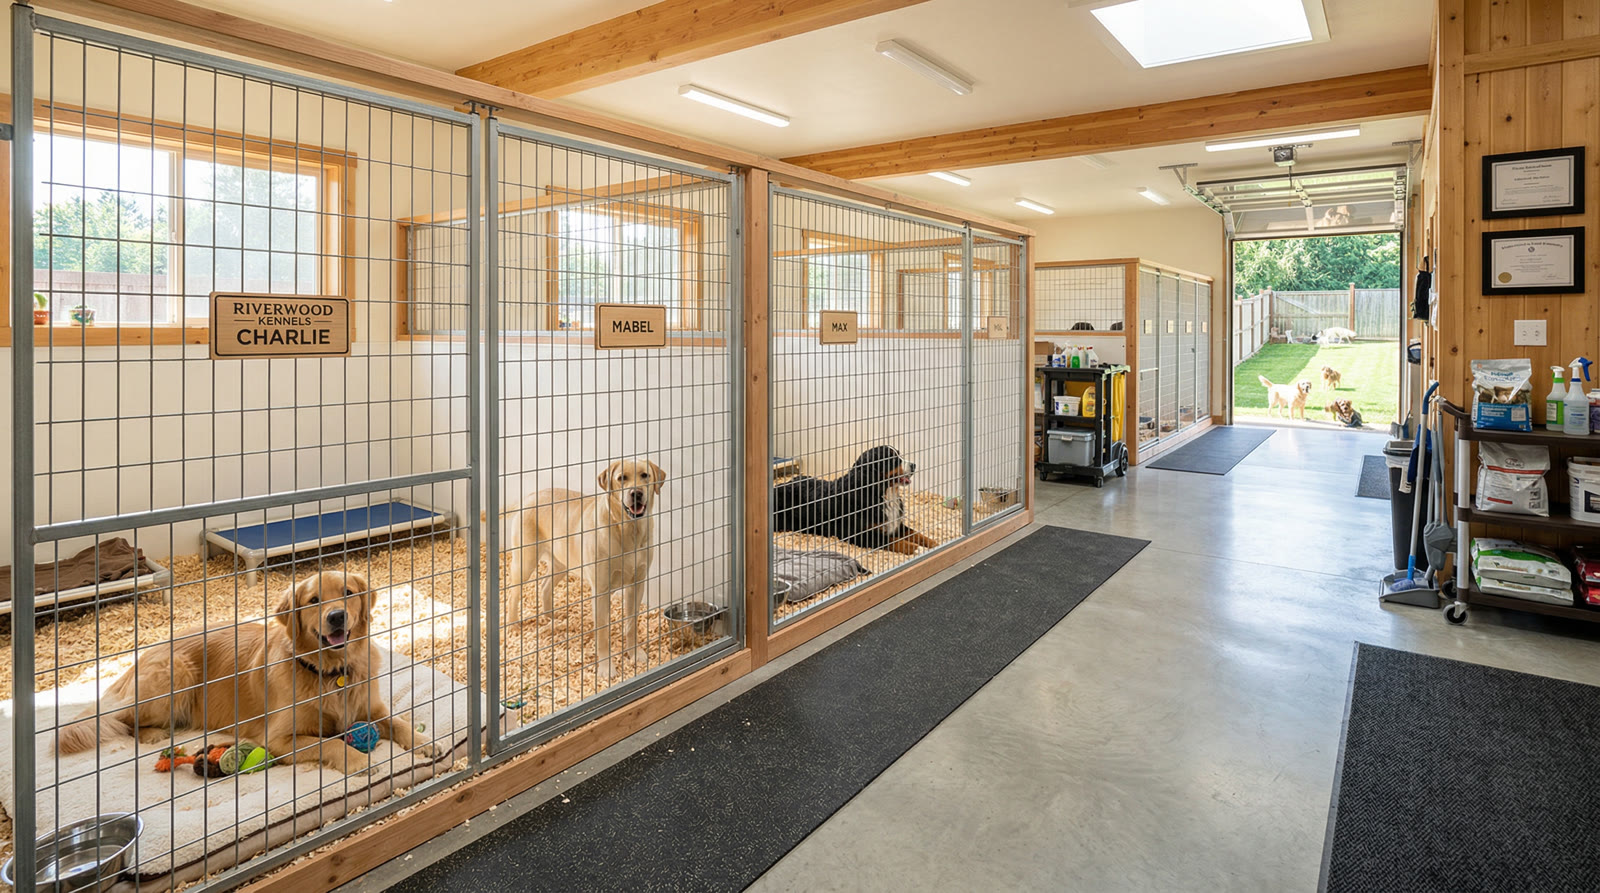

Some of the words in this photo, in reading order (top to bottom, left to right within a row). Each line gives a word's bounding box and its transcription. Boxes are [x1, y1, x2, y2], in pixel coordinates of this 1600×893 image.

[233, 302, 333, 316] RIVERWOOD
[258, 316, 311, 326] KENNELS
[612, 320, 654, 333] MABEL
[832, 322, 848, 332] MAX
[237, 328, 331, 346] CHARLIE
